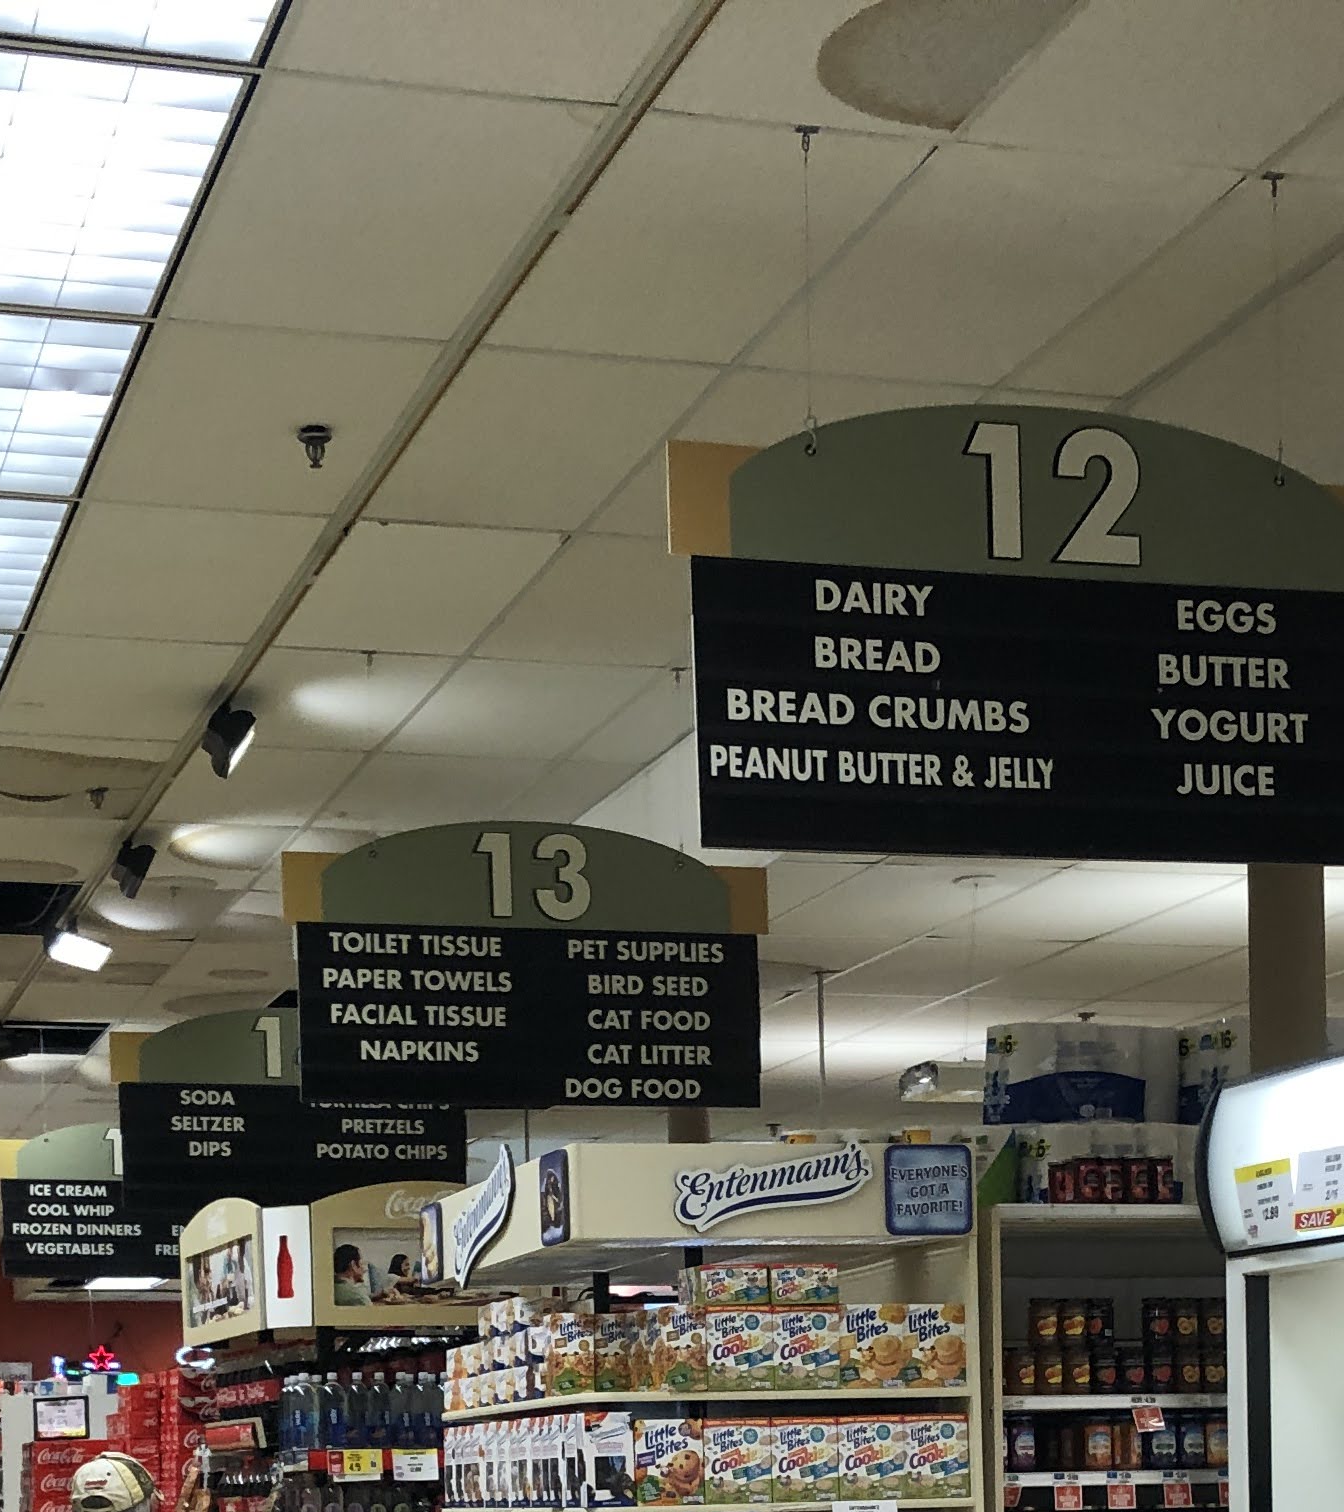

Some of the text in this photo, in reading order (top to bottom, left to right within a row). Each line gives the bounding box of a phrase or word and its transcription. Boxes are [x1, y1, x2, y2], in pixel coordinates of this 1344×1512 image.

[963, 420, 1142, 567] 12
[816, 580, 933, 616] DAIRY
[1177, 600, 1276, 634] EGGS
[815, 636, 940, 672] BREAD
[1159, 654, 1290, 688] BUTTER
[727, 689, 1029, 733] BREAD CRUMBS
[1151, 709, 1308, 743] YOGURT
[710, 745, 1053, 789] PEANUT BUTTER & JELLY
[1177, 764, 1274, 796] JUICE
[473, 832, 592, 921] 13
[329, 932, 501, 956] TOILET TISSUE
[568, 940, 723, 963] PET SUPPLIES
[323, 968, 512, 992] PAPER TOWELS
[588, 975, 708, 996] BIRD SEED
[331, 1004, 506, 1026] FACIAL TISSUE
[588, 1009, 710, 1030] CAT FOOD
[254, 1017, 300, 1079] 1
[361, 1040, 478, 1062] NAPKINS
[588, 1044, 711, 1065] CAT LITTER
[181, 1090, 235, 1105] SODA
[566, 1078, 701, 1098] DOG FOOD
[171, 1116, 244, 1131] SELTZER
[342, 1119, 424, 1134] PRETZELS
[190, 1142, 231, 1156] DIPS
[317, 1144, 447, 1160] POTATO CHIPS
[30, 1184, 106, 1196] ICE CREAM
[680, 1144, 868, 1219] Entenmann's
[910, 1183, 950, 1198] GOT A
[28, 1204, 114, 1216] COOL WHIP
[897, 1200, 963, 1216] FAVORITE!
[13, 1223, 141, 1235] FROZEN DINNERS
[1299, 1210, 1331, 1228] SAVE
[26, 1243, 114, 1255] VEGETABLES
[714, 1315, 737, 1332] Little
[781, 1314, 804, 1332] Little
[846, 1308, 877, 1333] Little
[908, 1308, 939, 1333] Little
[721, 1324, 745, 1339] Bites
[789, 1324, 812, 1339] Bites
[855, 1321, 889, 1343] Bites
[918, 1321, 951, 1343] Bites
[644, 1424, 677, 1450] Little
[712, 1428, 735, 1447] Little
[779, 1427, 803, 1445] Little
[846, 1424, 869, 1443] Little
[853, 1434, 876, 1449] Bites
[910, 1423, 932, 1442] Little
[917, 1433, 940, 1448] Bites
[655, 1438, 689, 1460] Bites
[720, 1437, 744, 1451] Bites
[787, 1436, 810, 1451] Bites
